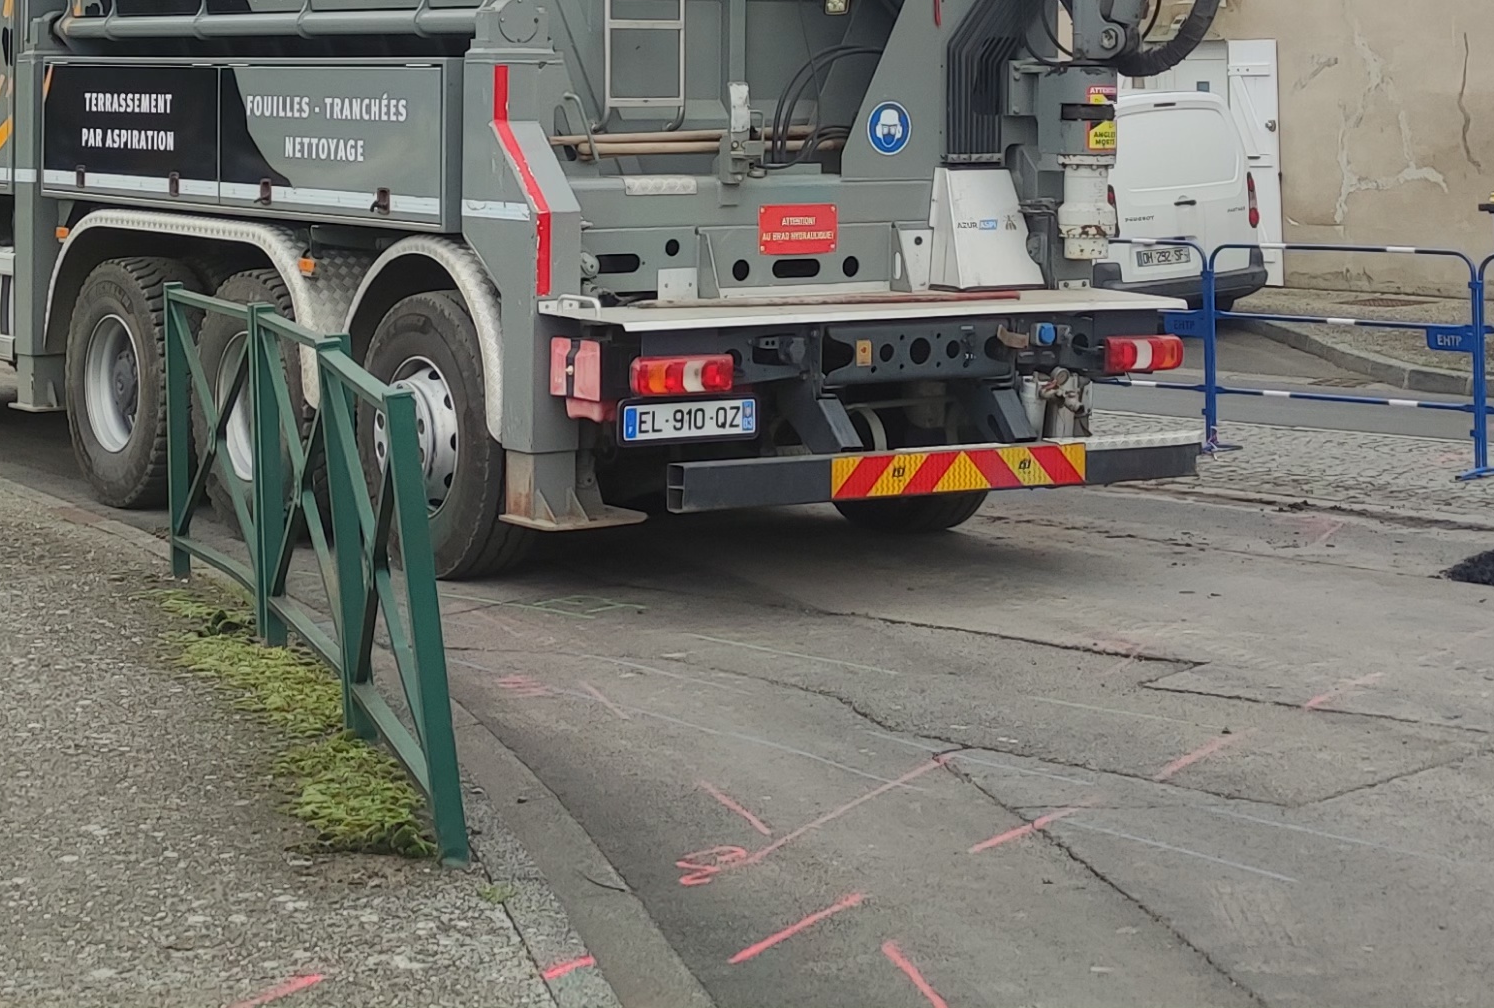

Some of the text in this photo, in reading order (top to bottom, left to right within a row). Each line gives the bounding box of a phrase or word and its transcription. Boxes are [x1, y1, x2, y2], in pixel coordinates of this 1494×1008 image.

[84, 92, 173, 114] TERRASSEMENT
[246, 95, 310, 118] FOUILLES
[324, 92, 408, 122] TRANCHÉES
[82, 128, 175, 152] PAR ASPIRATION
[284, 136, 365, 162] NETTOYAGE
[1437, 334, 1462, 347] EHTP
